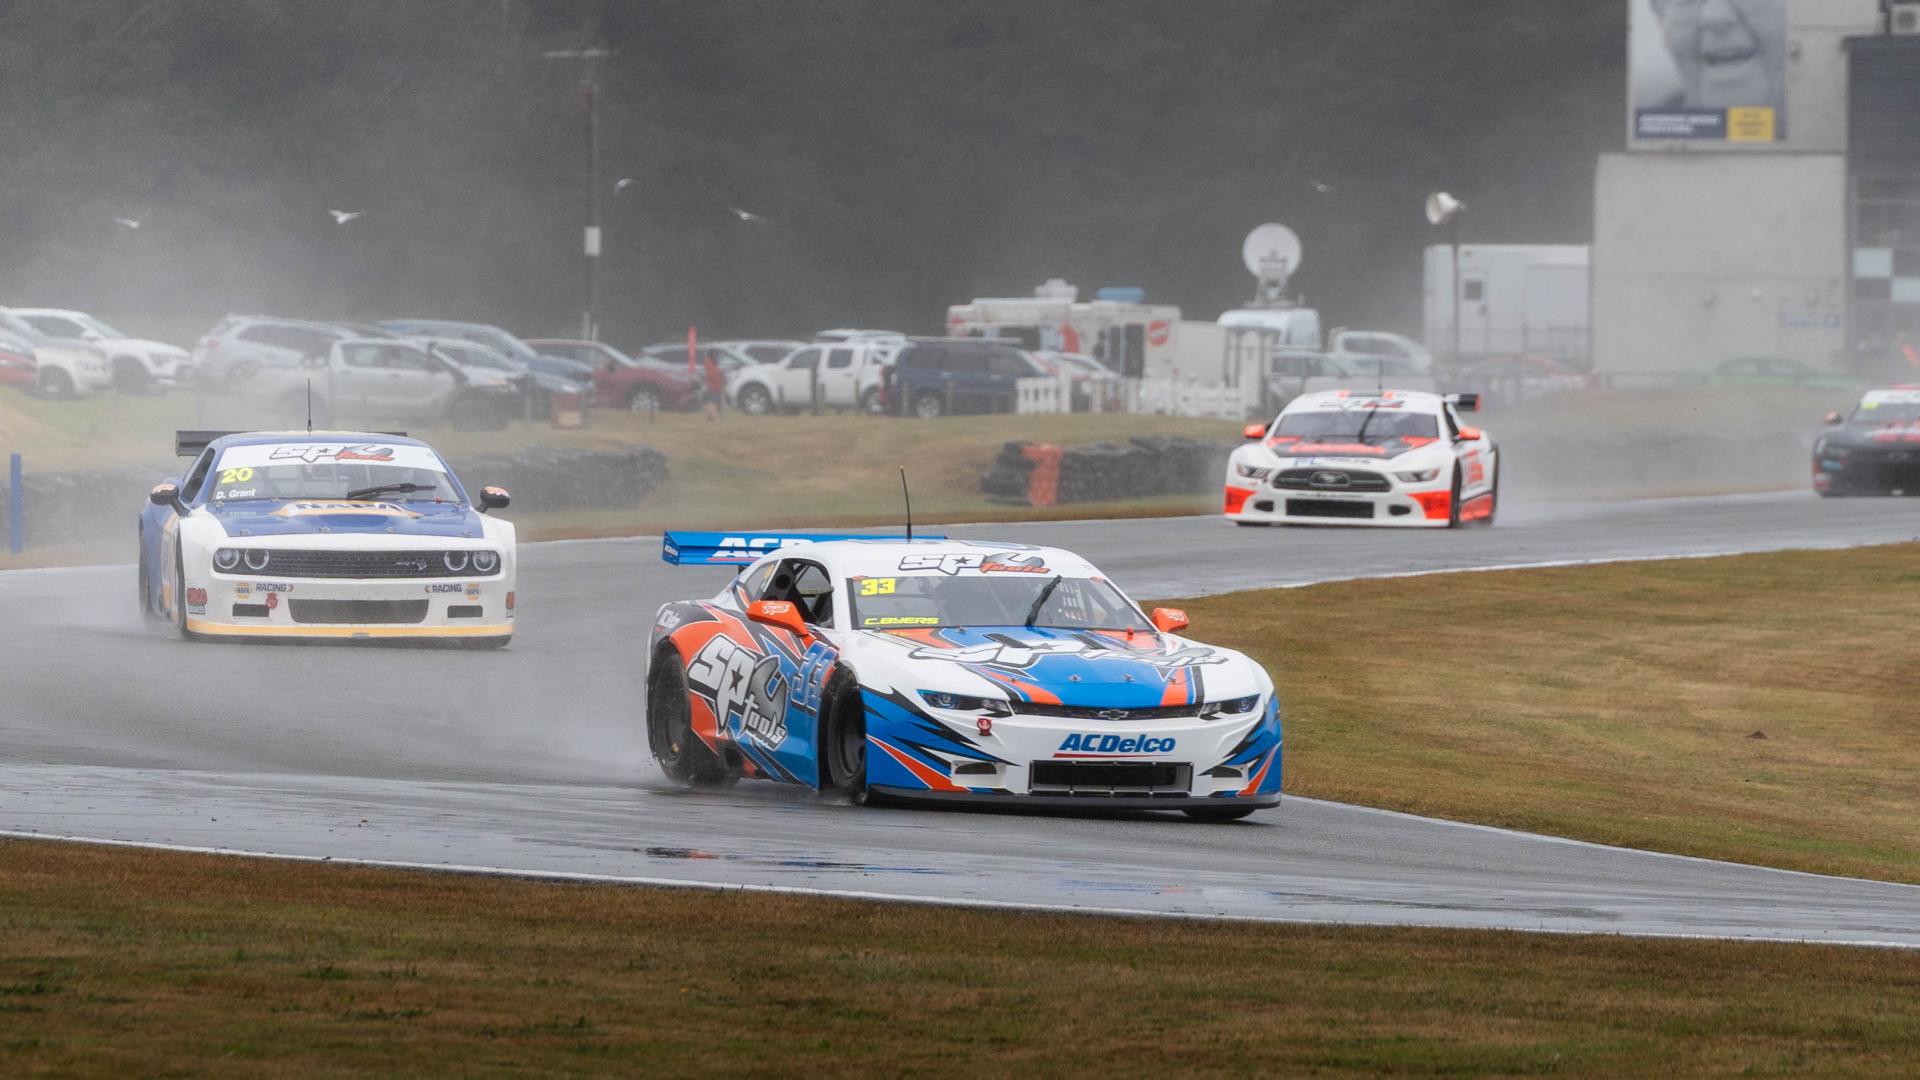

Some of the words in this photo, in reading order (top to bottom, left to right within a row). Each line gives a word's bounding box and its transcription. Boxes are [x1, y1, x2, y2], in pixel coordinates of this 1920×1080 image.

[220, 467, 253, 484] 20
[216, 491, 226, 499] D.
[229, 488, 256, 498] Grant
[898, 553, 987, 576] SP
[255, 583, 287, 592] RACING
[432, 584, 463, 593] RACING
[861, 578, 895, 595] 33
[687, 634, 757, 738] SP
[1058, 733, 1176, 753] ACDelco
